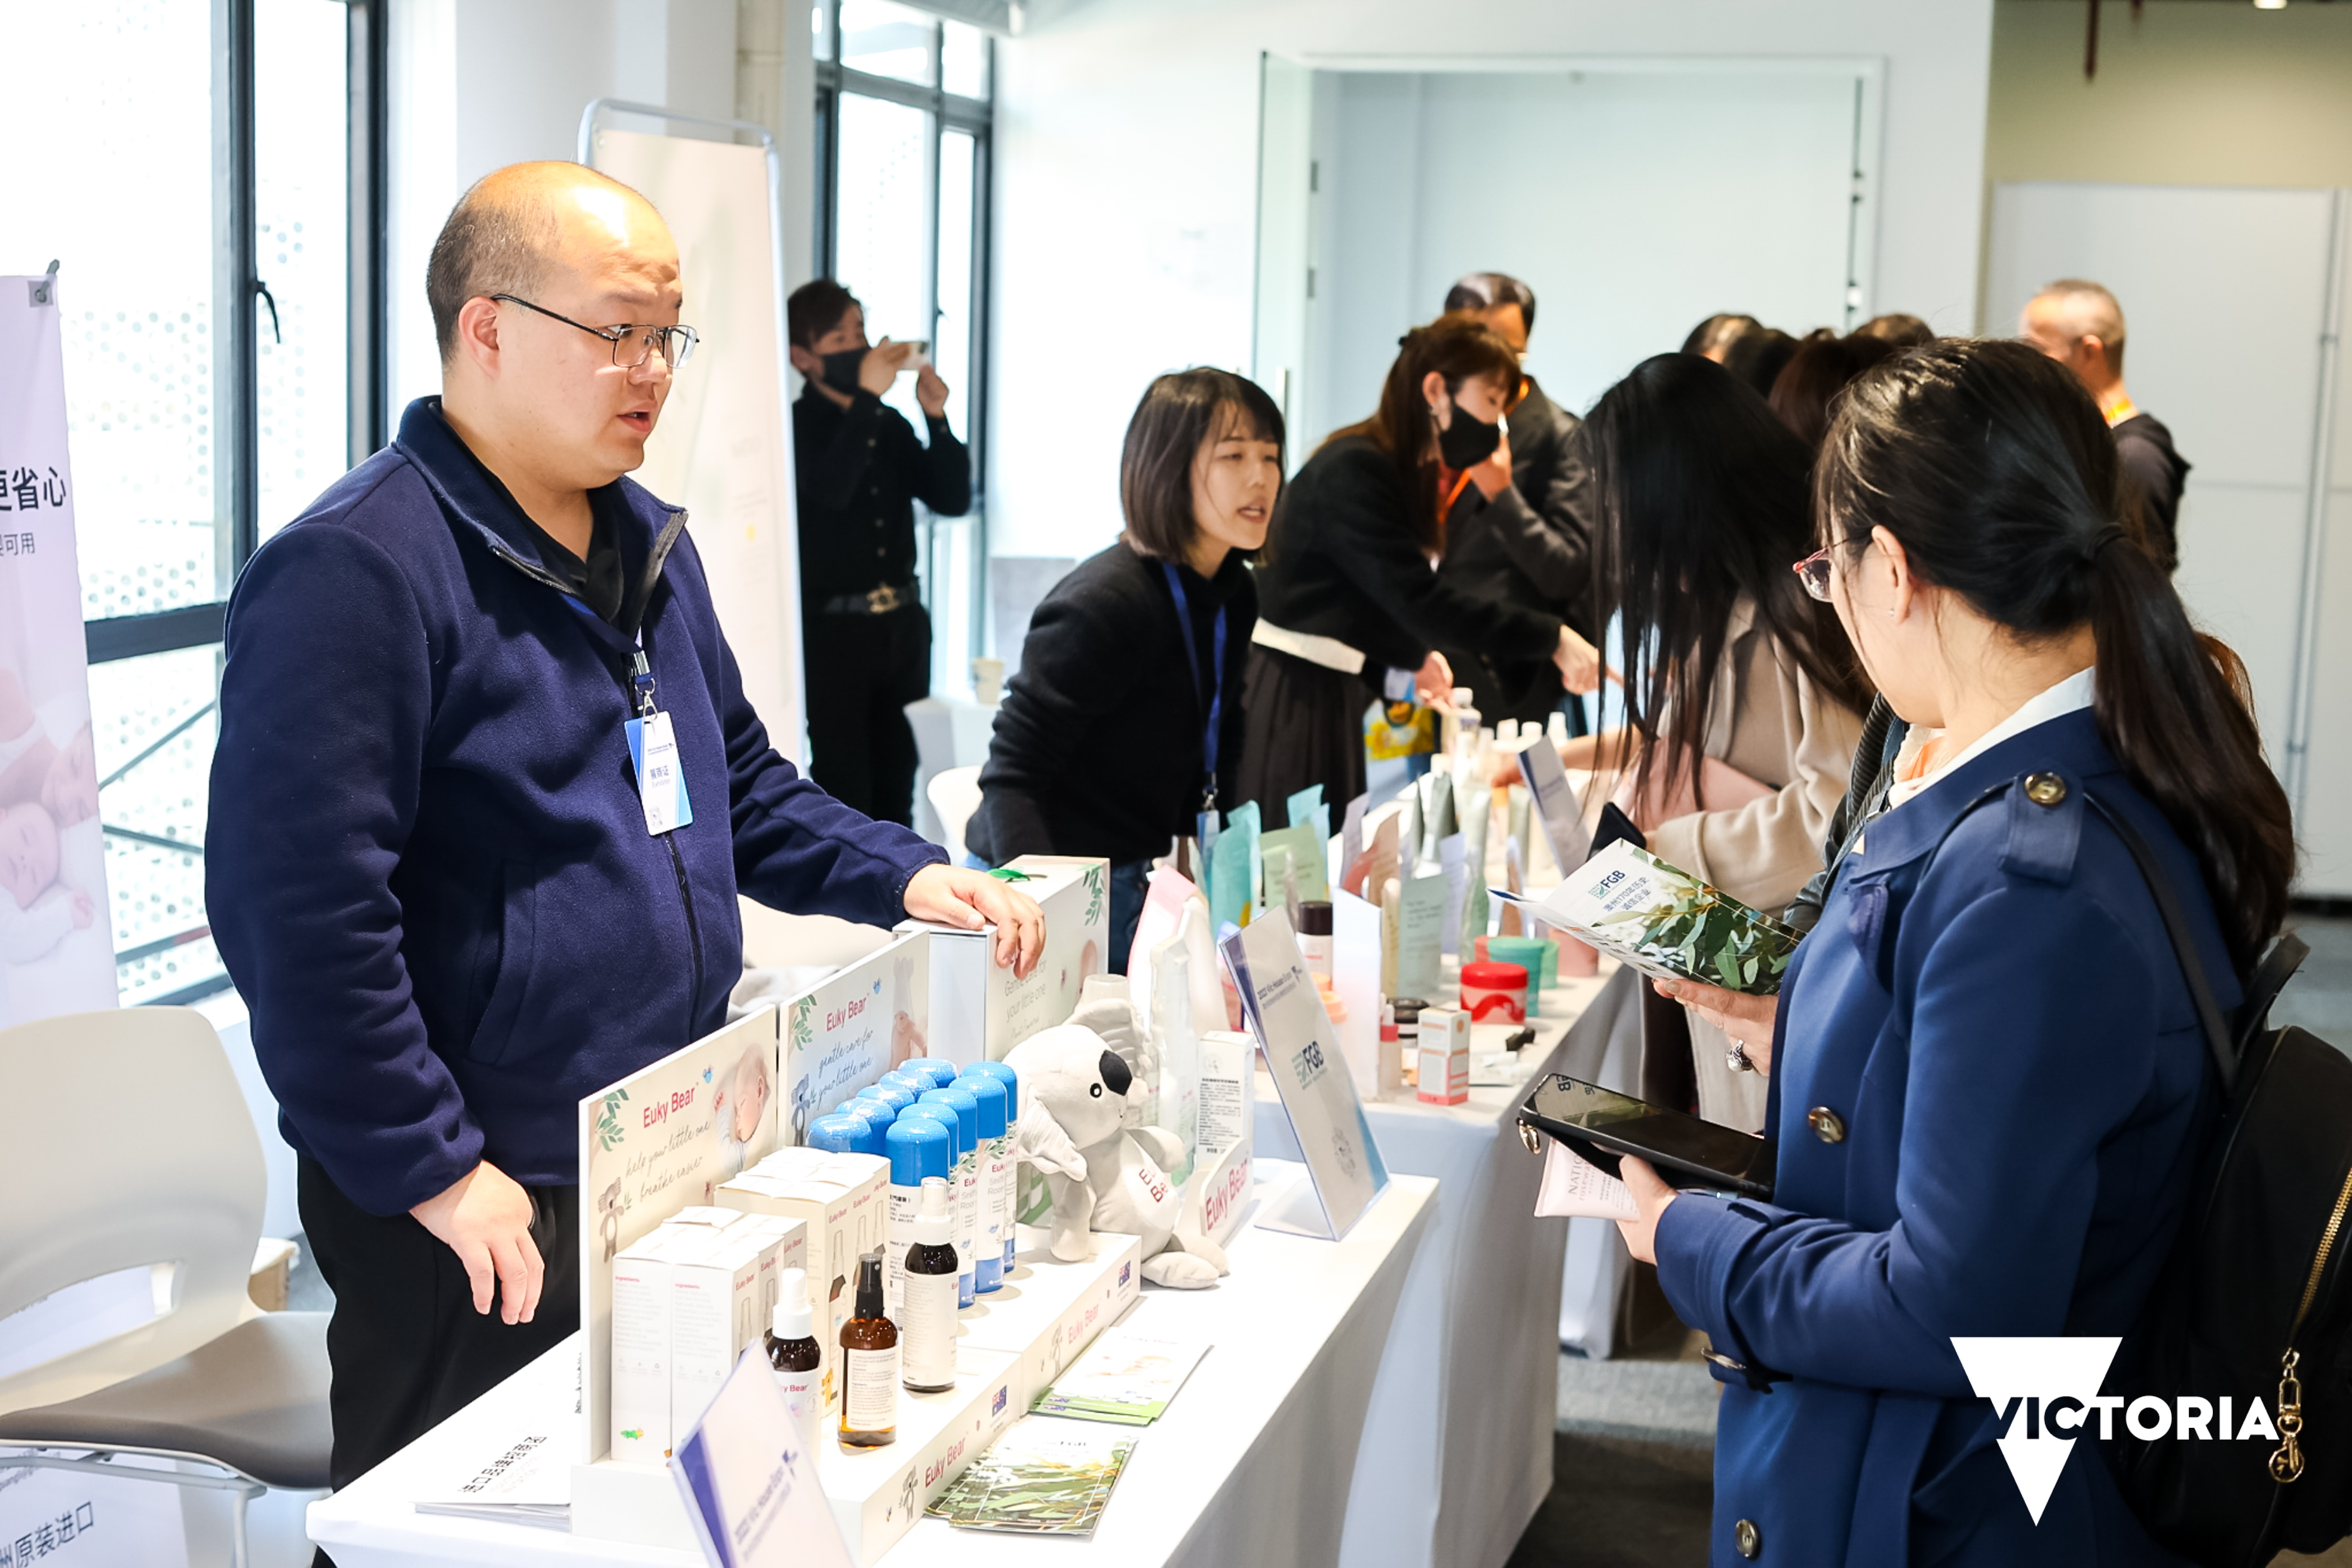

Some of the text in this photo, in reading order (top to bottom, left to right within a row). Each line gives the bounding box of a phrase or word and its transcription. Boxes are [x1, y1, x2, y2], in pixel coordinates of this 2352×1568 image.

[1600, 870, 1626, 889] FGB
[826, 997, 866, 1032] Euky Bear
[818, 1027, 873, 1079] gentle care for
[1303, 1040, 1324, 1075] FGB
[817, 1057, 873, 1110] your little one
[644, 1087, 695, 1128] Euky Bear
[626, 1121, 711, 1178] help your little one
[641, 1156, 702, 1202] breathe easier
[1151, 1181, 1168, 1203] Be
[1206, 1158, 1248, 1231] Euky Bear
[1069, 1304, 1098, 1345] Euky Bear
[925, 1437, 966, 1488] Euky Bear
